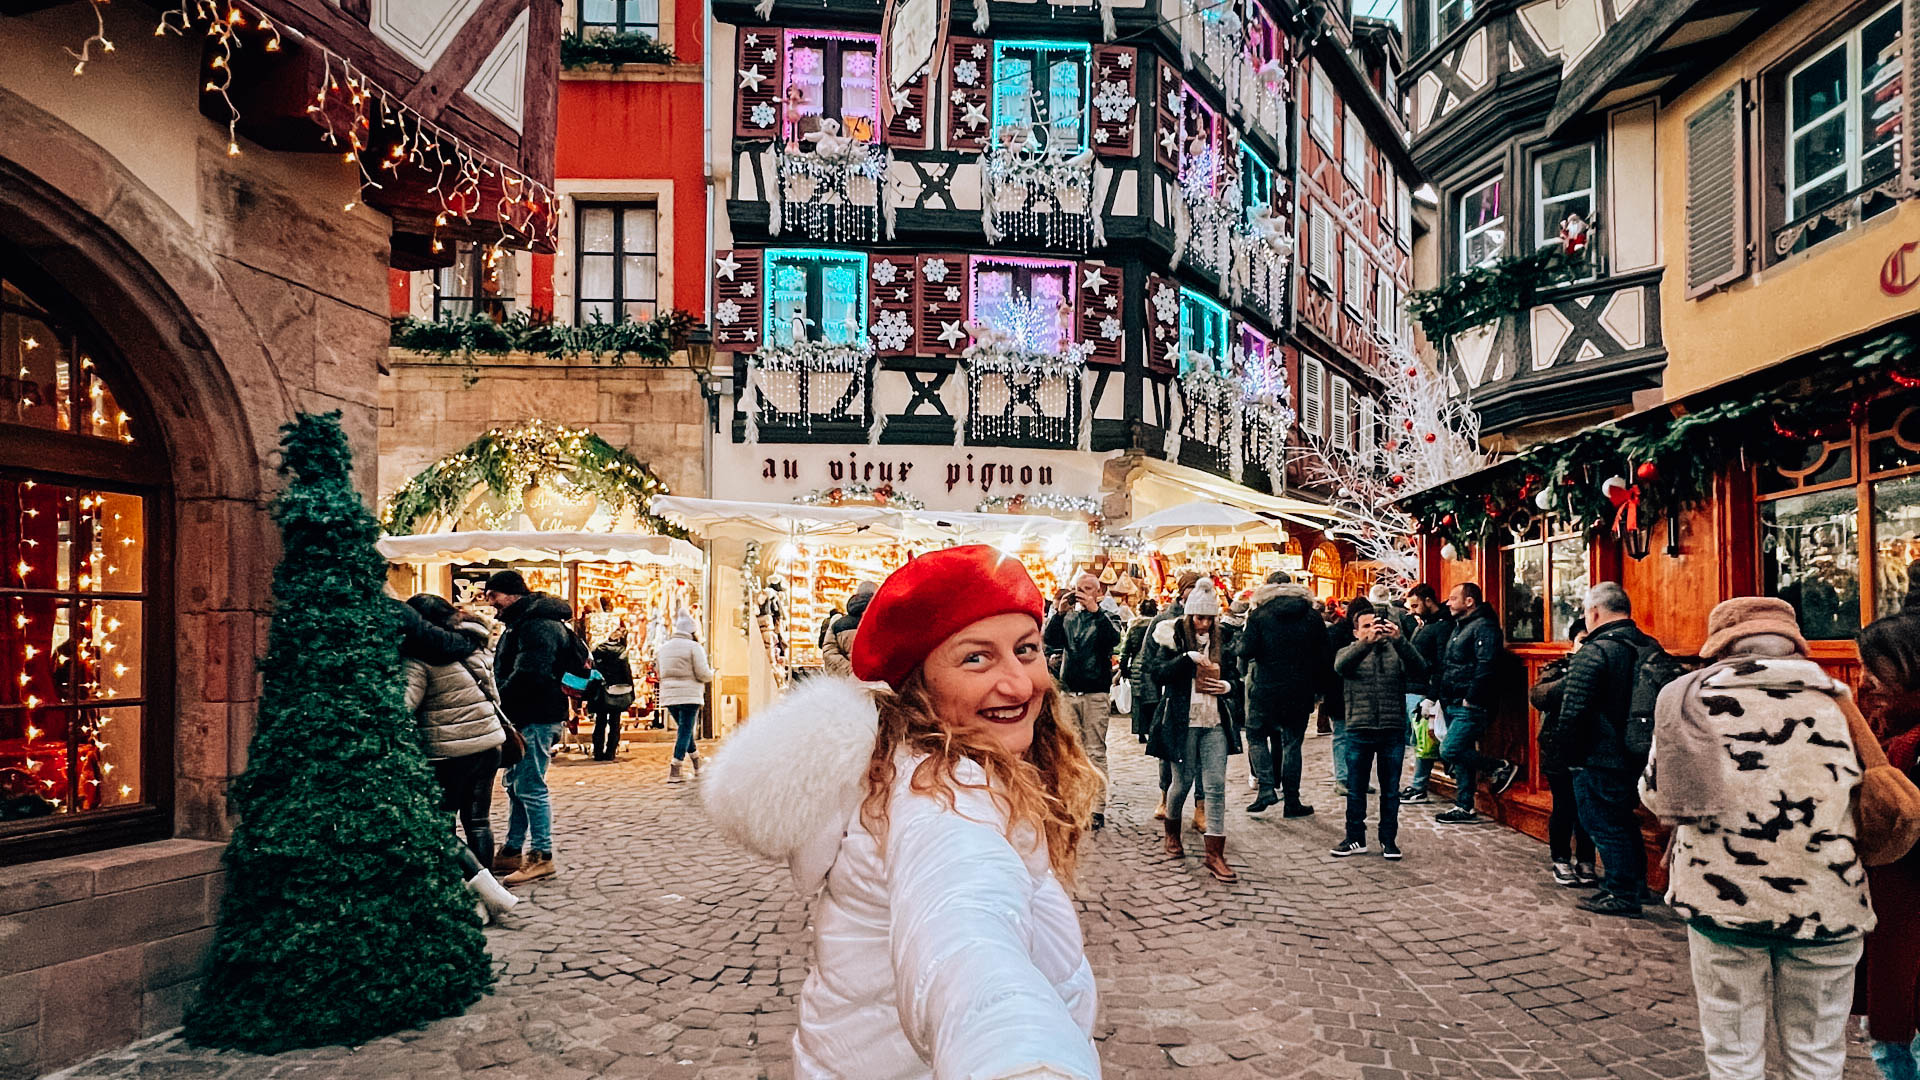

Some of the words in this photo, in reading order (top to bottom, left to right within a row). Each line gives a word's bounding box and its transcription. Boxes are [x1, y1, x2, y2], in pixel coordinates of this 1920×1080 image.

[762, 457, 799, 480] au
[828, 451, 914, 482] vieux
[944, 453, 1053, 493] pignon
